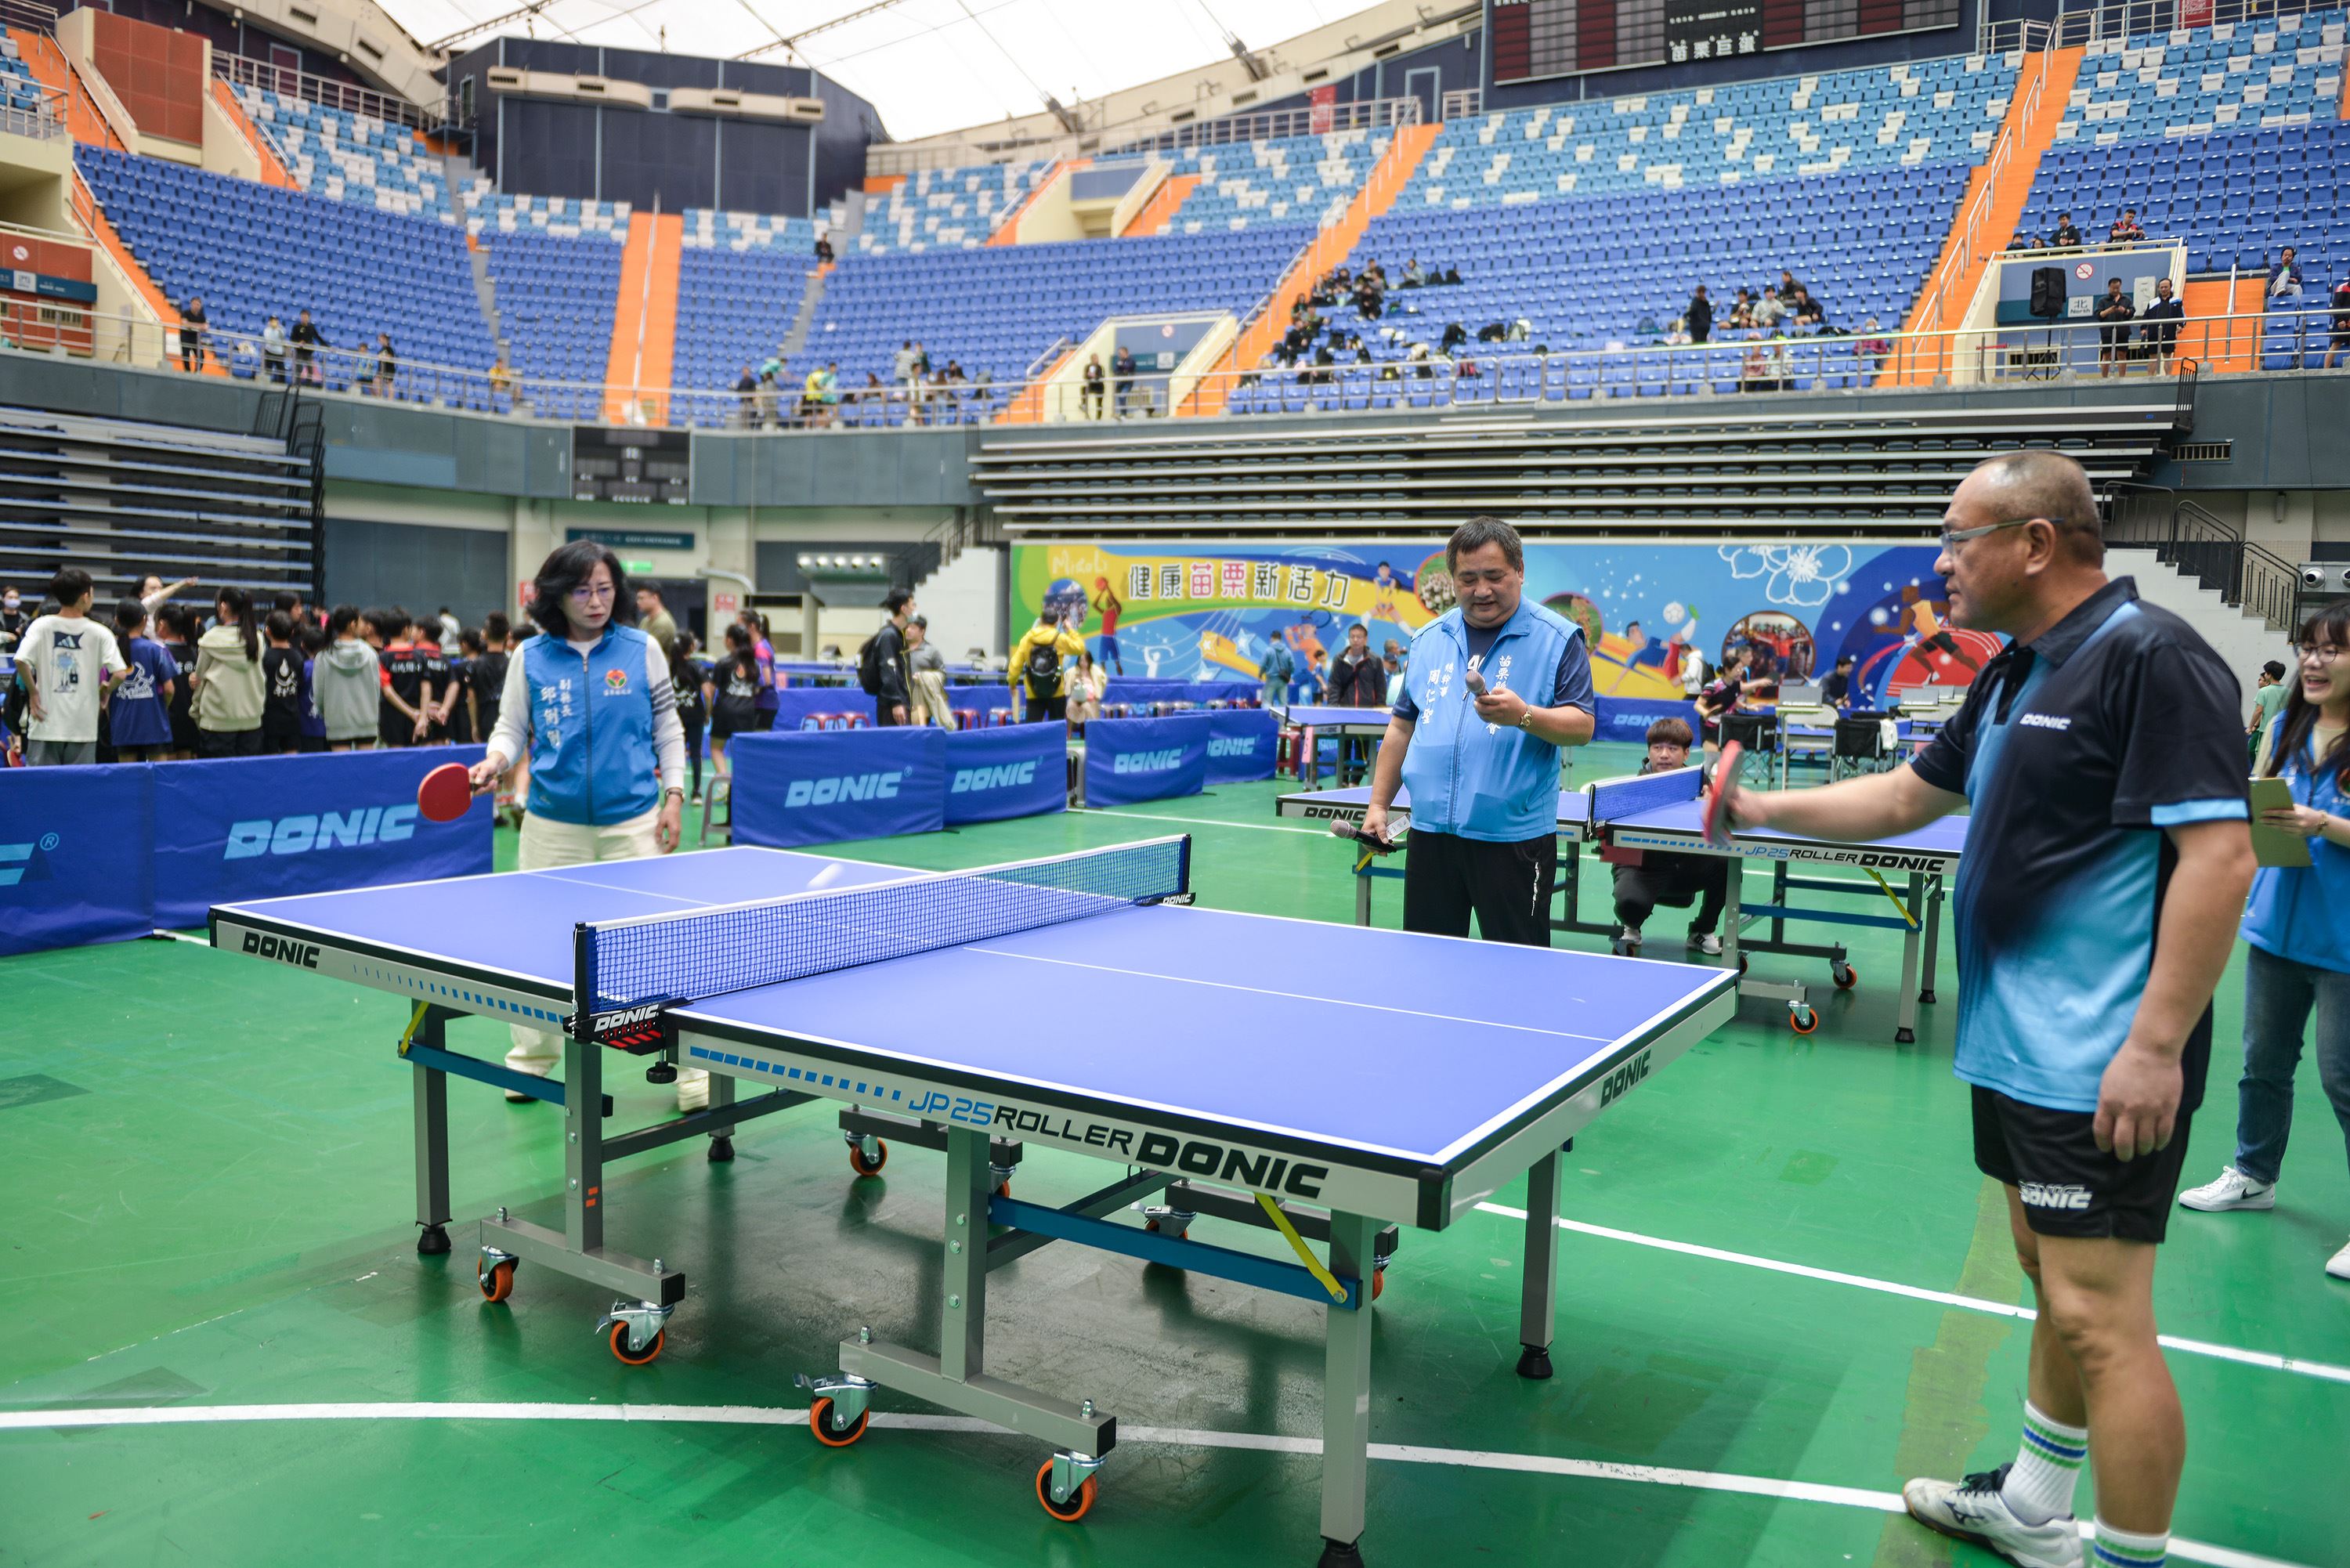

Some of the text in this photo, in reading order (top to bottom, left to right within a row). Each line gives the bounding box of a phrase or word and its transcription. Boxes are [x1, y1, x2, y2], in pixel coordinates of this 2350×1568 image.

[1129, 561, 1350, 608] 健康苗栗新活力
[1613, 714, 1664, 727] DON
[2019, 713, 2071, 730] DONIC
[1114, 749, 1181, 774] DONIC
[785, 771, 902, 807] DONIC
[951, 761, 1036, 793] DONIC
[1303, 807, 1367, 822] DONIC
[223, 804, 420, 860] DONIC
[1789, 849, 1858, 864] ROLLER
[1858, 854, 1946, 872] DONIC
[1162, 894, 1191, 905] DONIC
[242, 931, 320, 969] DONIC
[595, 1003, 659, 1032] DONIC
[1600, 1049, 1651, 1109] DONIC
[993, 1105, 1133, 1155] ROLLER
[1135, 1132, 1329, 1199] DONIC
